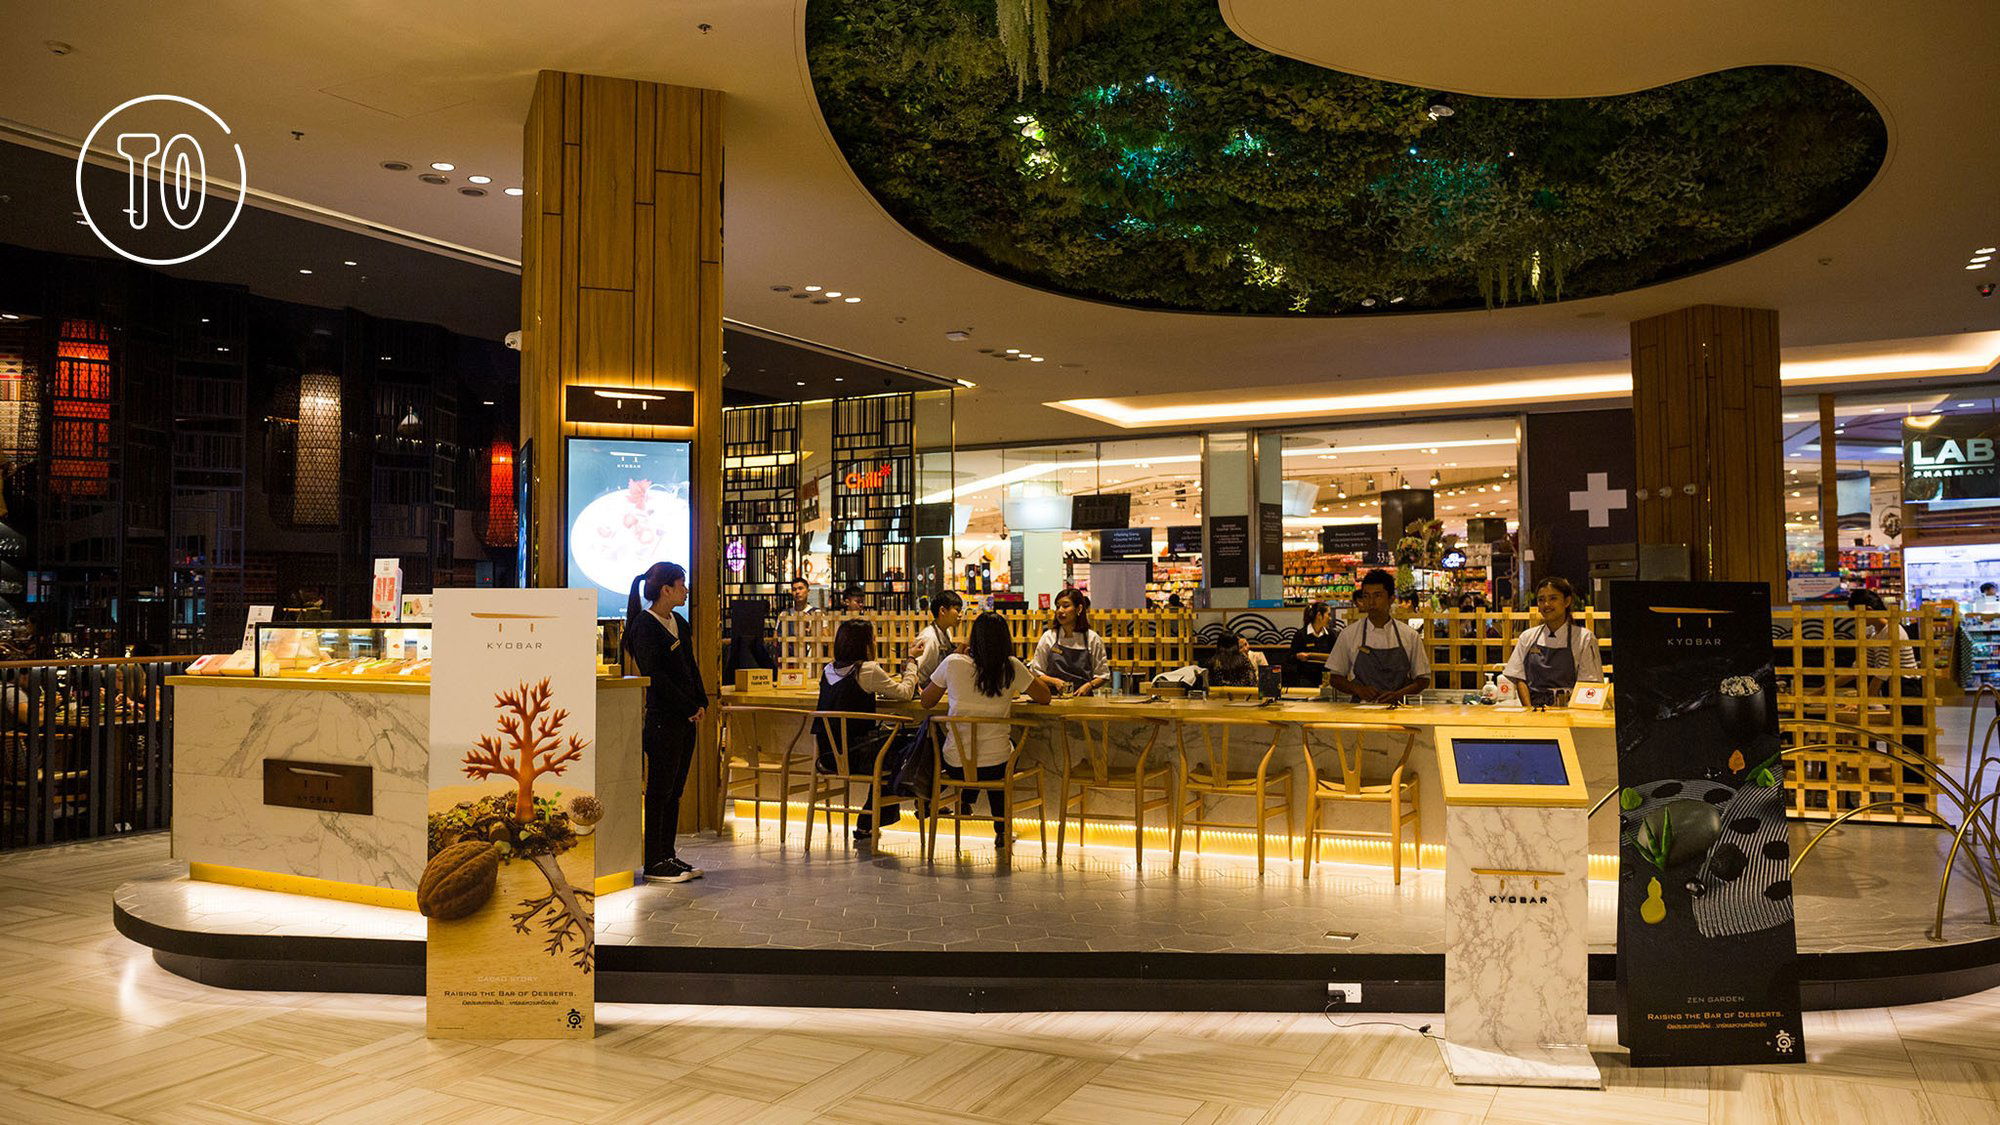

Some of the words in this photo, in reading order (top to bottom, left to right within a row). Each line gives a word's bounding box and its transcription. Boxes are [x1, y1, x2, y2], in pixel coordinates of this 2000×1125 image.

[1912, 438, 1995, 465] LAB
[1912, 468, 1994, 479] PHARMACY
[486, 642, 543, 650] KYOBAR
[1666, 638, 1722, 646] KYOBAR
[1489, 896, 1548, 904] KYOBAR
[1707, 995, 1745, 1003] GARDEN
